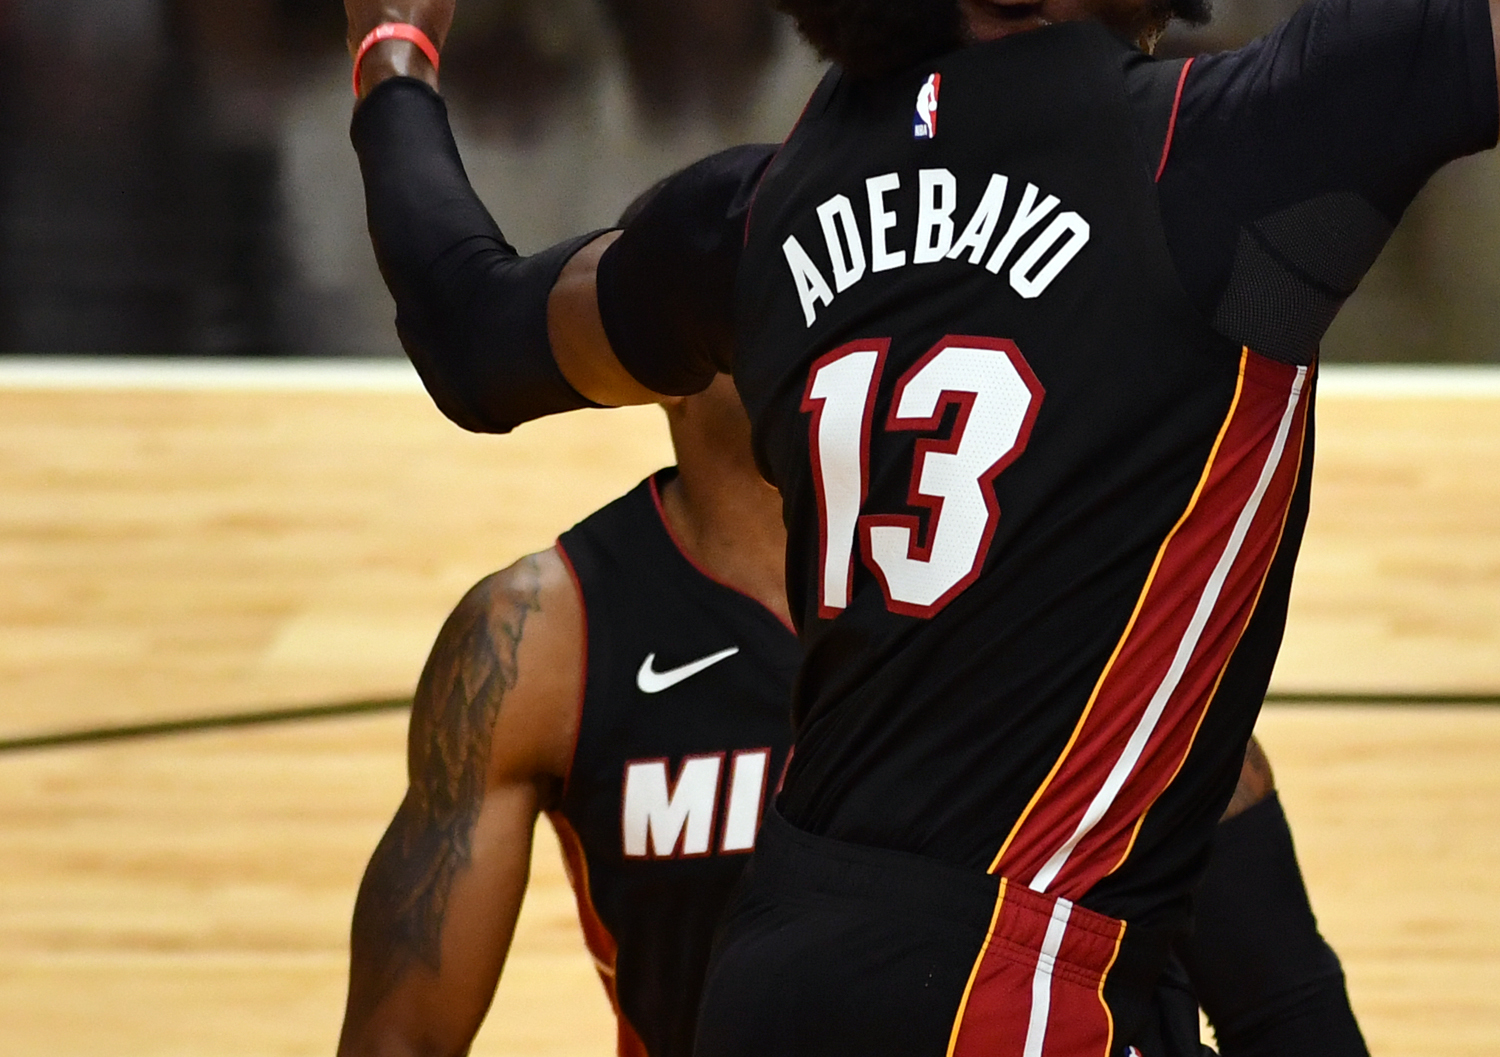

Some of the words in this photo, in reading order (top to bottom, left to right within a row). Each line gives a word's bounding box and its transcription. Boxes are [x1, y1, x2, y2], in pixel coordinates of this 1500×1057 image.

[782, 168, 1090, 328] ADEBAYO
[801, 334, 1046, 620] 13
[621, 746, 772, 861] MI
